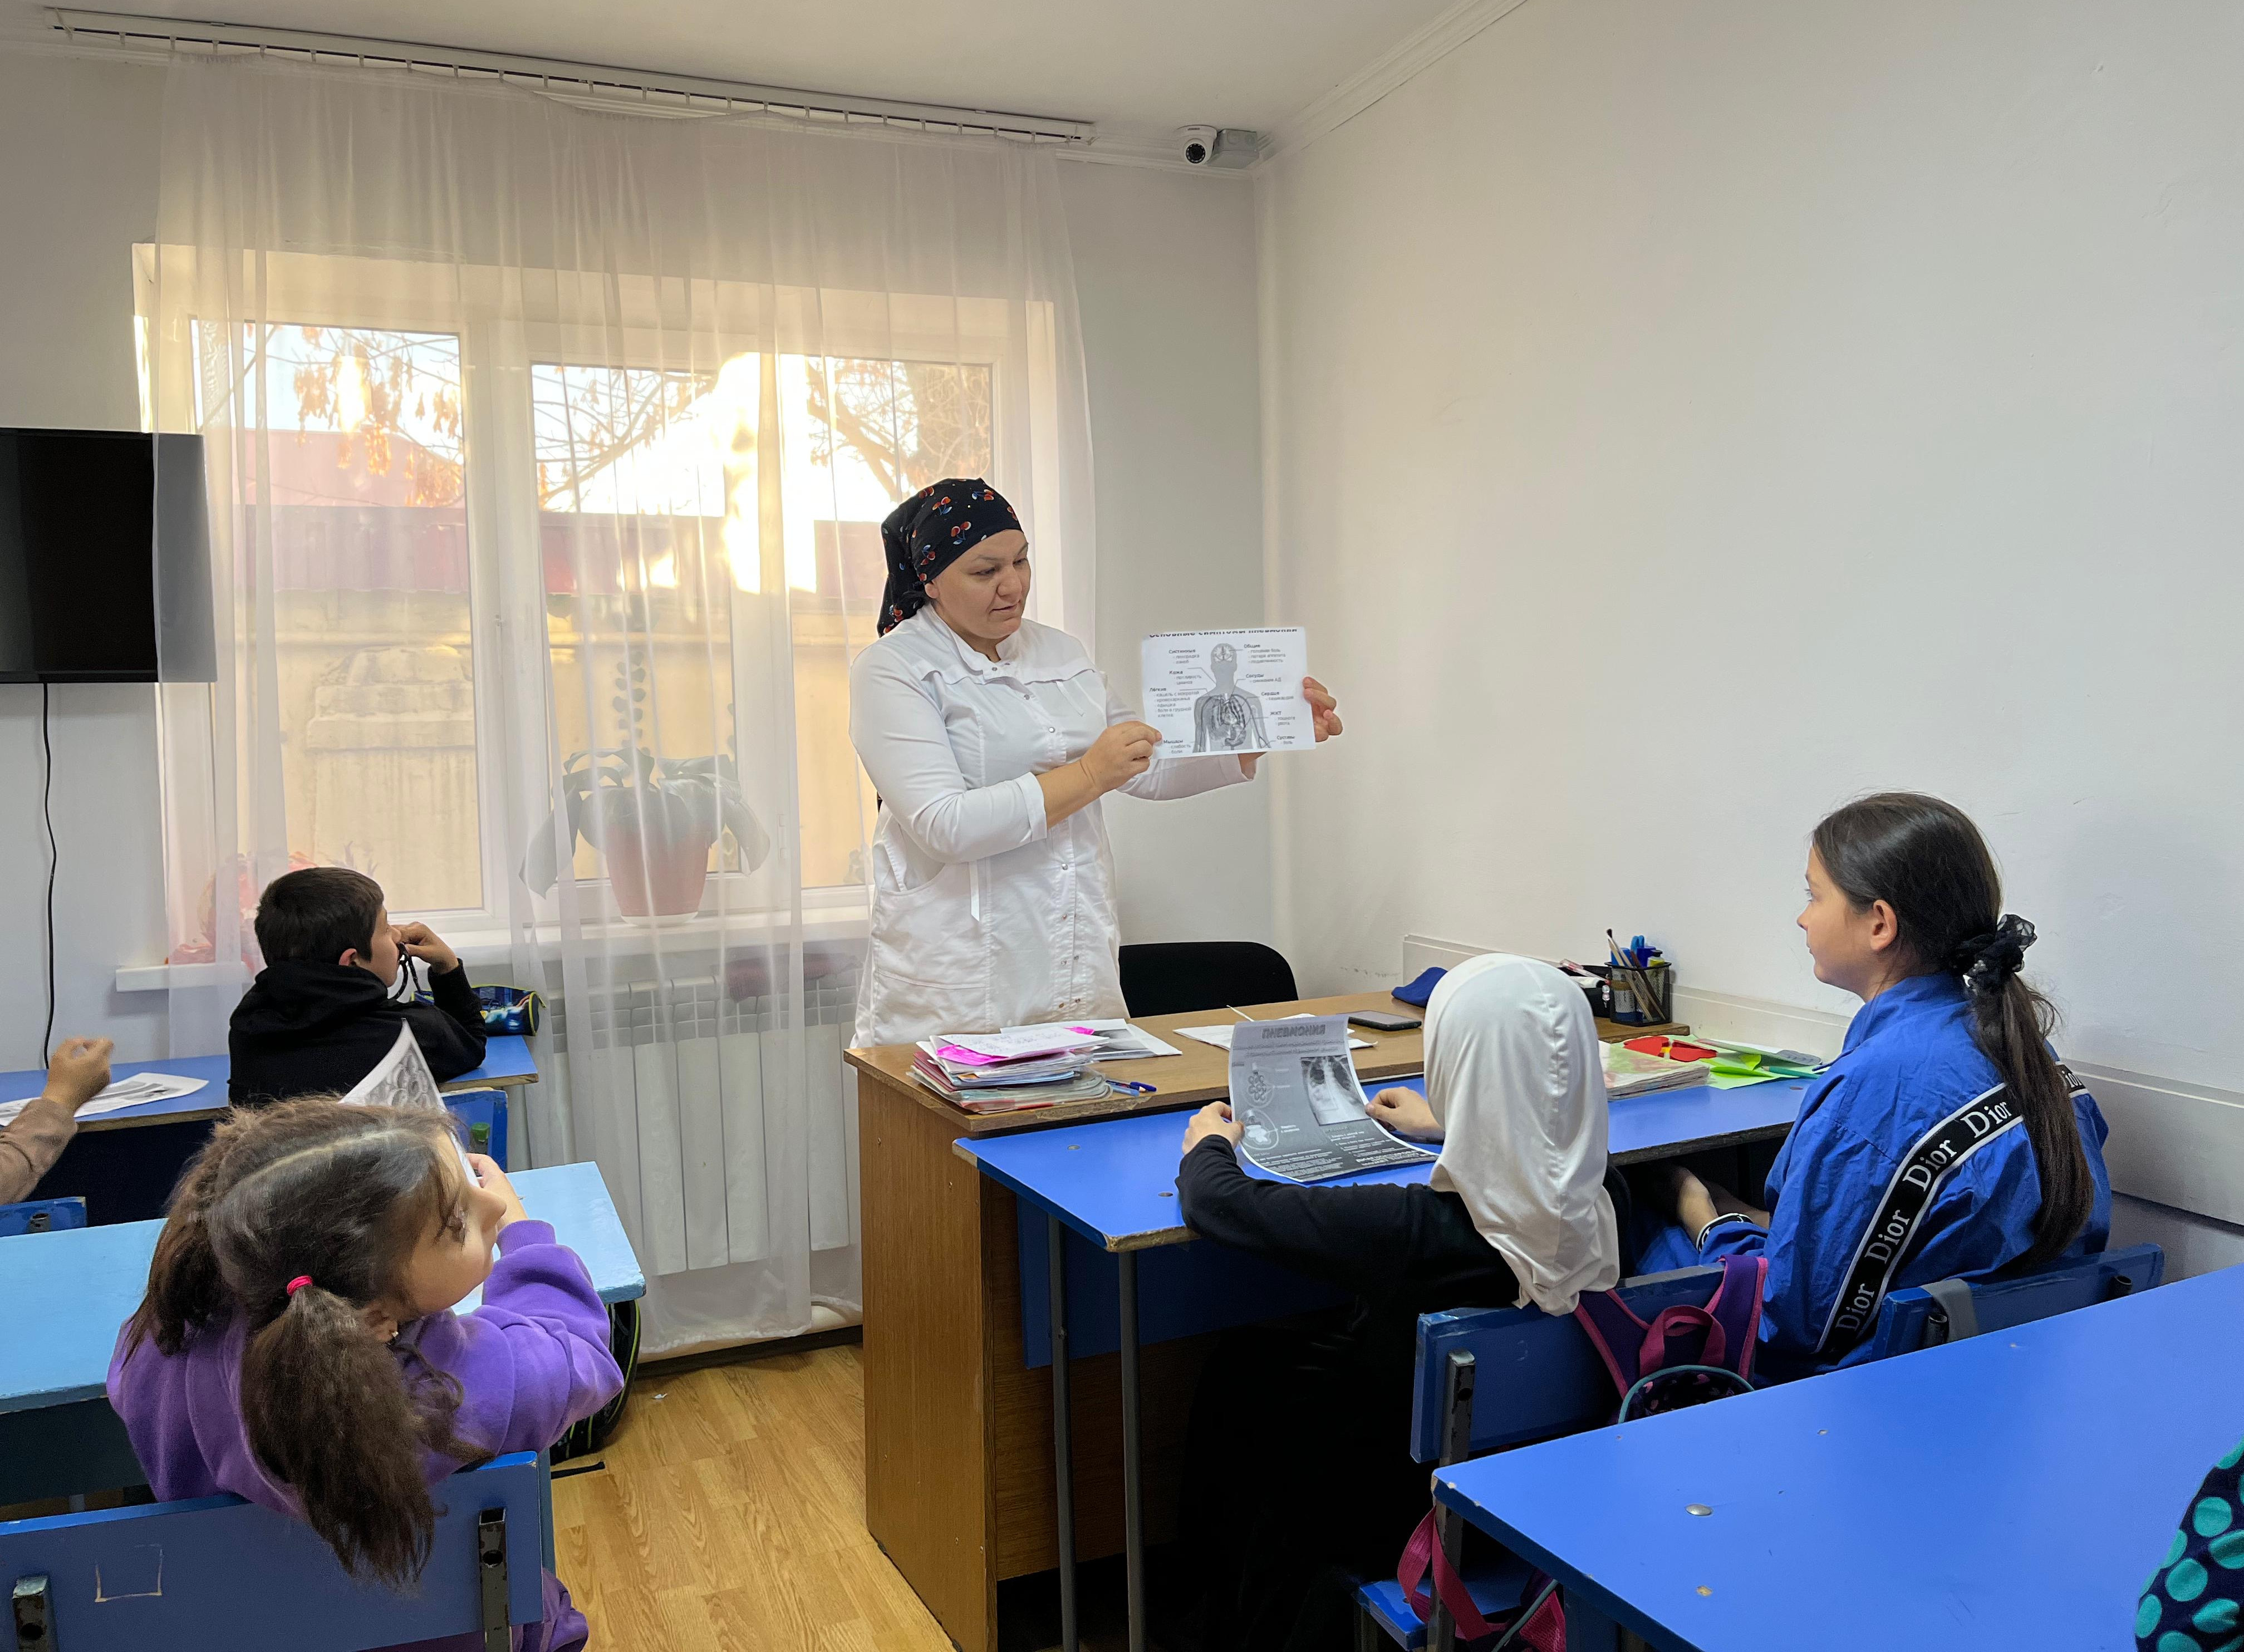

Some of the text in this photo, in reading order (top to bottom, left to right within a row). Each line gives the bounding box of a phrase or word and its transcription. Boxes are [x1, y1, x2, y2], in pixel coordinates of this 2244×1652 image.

[1261, 1024, 1325, 1039] ПНЕВМОНИЯ
[1835, 1100, 2012, 1331] Dior Dior Dior Dior
